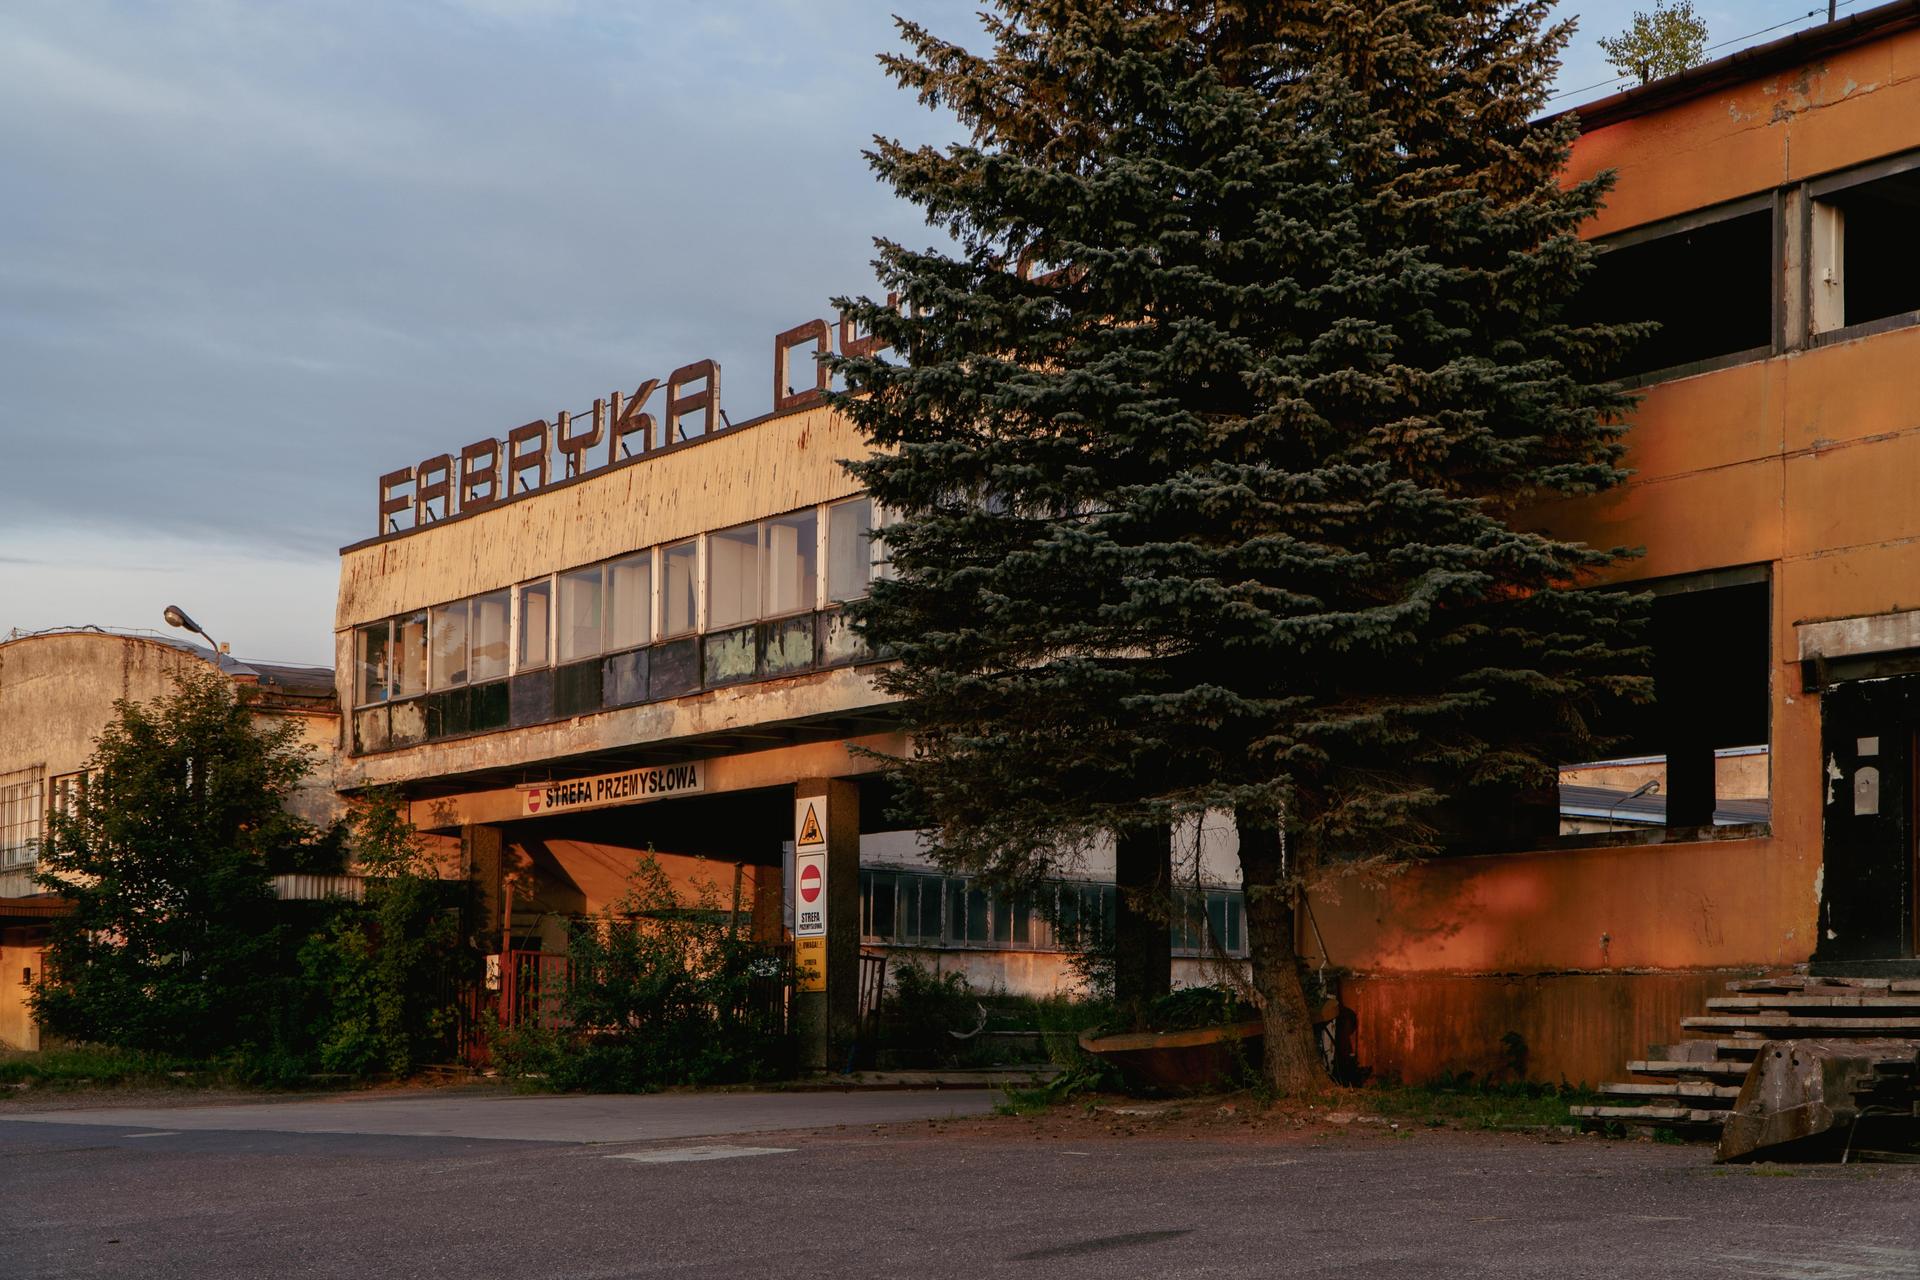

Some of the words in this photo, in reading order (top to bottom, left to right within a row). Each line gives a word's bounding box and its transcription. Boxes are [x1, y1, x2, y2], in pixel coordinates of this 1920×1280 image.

[379, 359, 721, 536] FABRYKA
[546, 782, 592, 808] STREFA
[597, 765, 697, 801] PRZEMYSŁOWA
[801, 912, 820, 923] STREFA
